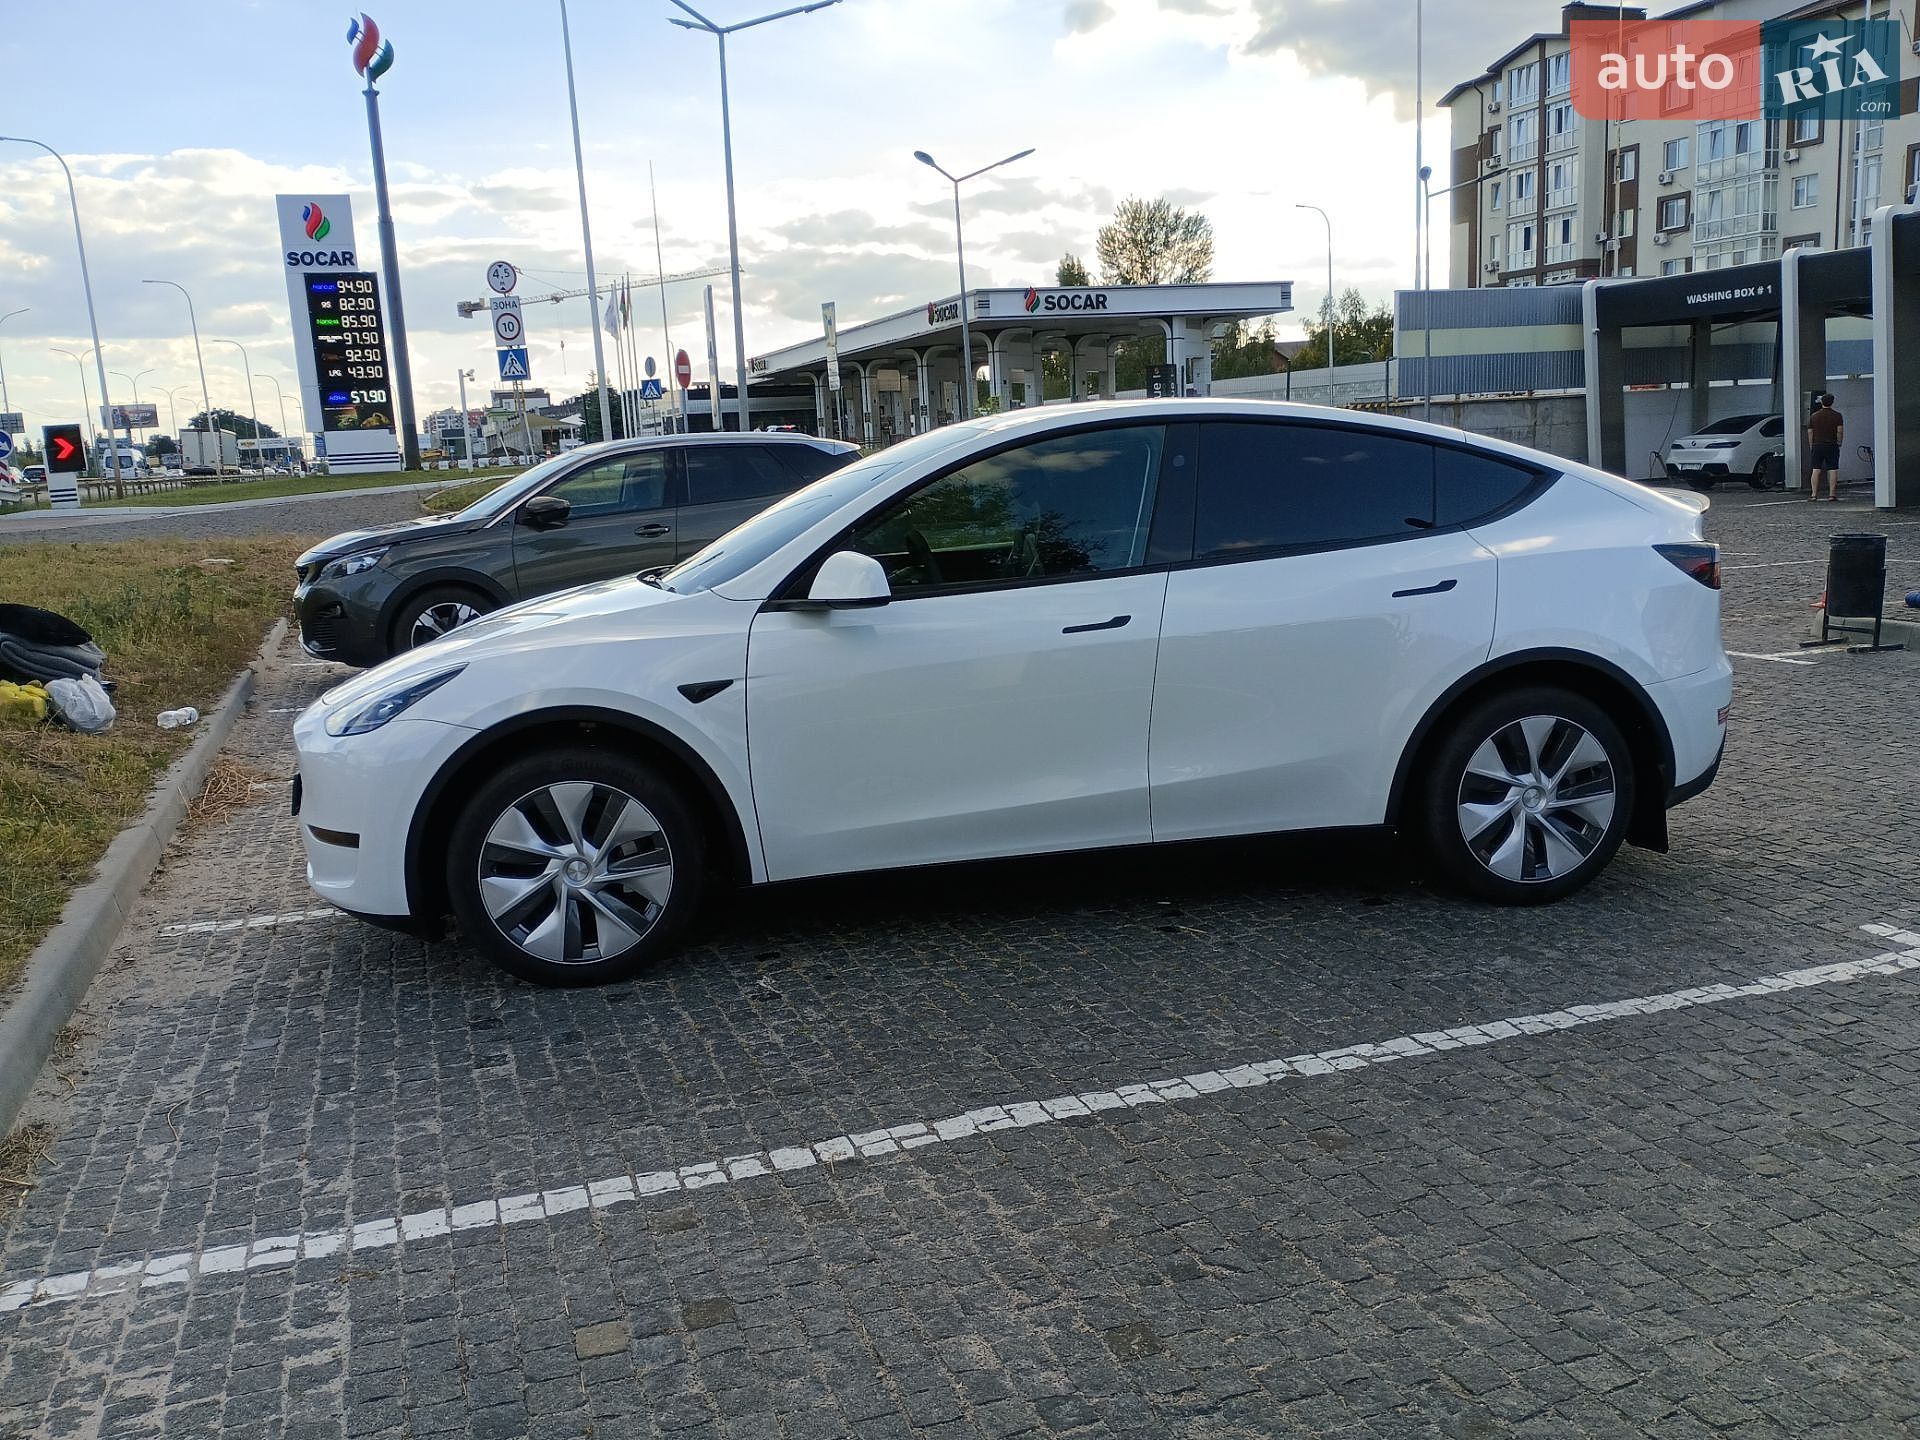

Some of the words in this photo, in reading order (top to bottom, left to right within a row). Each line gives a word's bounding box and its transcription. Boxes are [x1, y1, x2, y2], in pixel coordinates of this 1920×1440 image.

[287, 251, 355, 266] SOCAR
[492, 268, 510, 279] 4,5
[337, 280, 372, 293] 94.90
[1686, 290, 1732, 304] WASHING
[1734, 287, 1755, 298] BOX
[1757, 285, 1764, 295] #
[1767, 284, 1772, 294] 1
[339, 298, 375, 310] 82.90
[493, 300, 518, 310] ЗОНА
[1044, 293, 1108, 311] SOCAR
[935, 302, 959, 322] SOCAR
[341, 315, 377, 328] 85.90
[502, 321, 515, 333] 10
[343, 332, 379, 345] 97.90
[345, 349, 381, 362] 92.90
[328, 369, 342, 377] LPG
[347, 366, 383, 379] 43.90
[350, 390, 387, 403] 57.90
